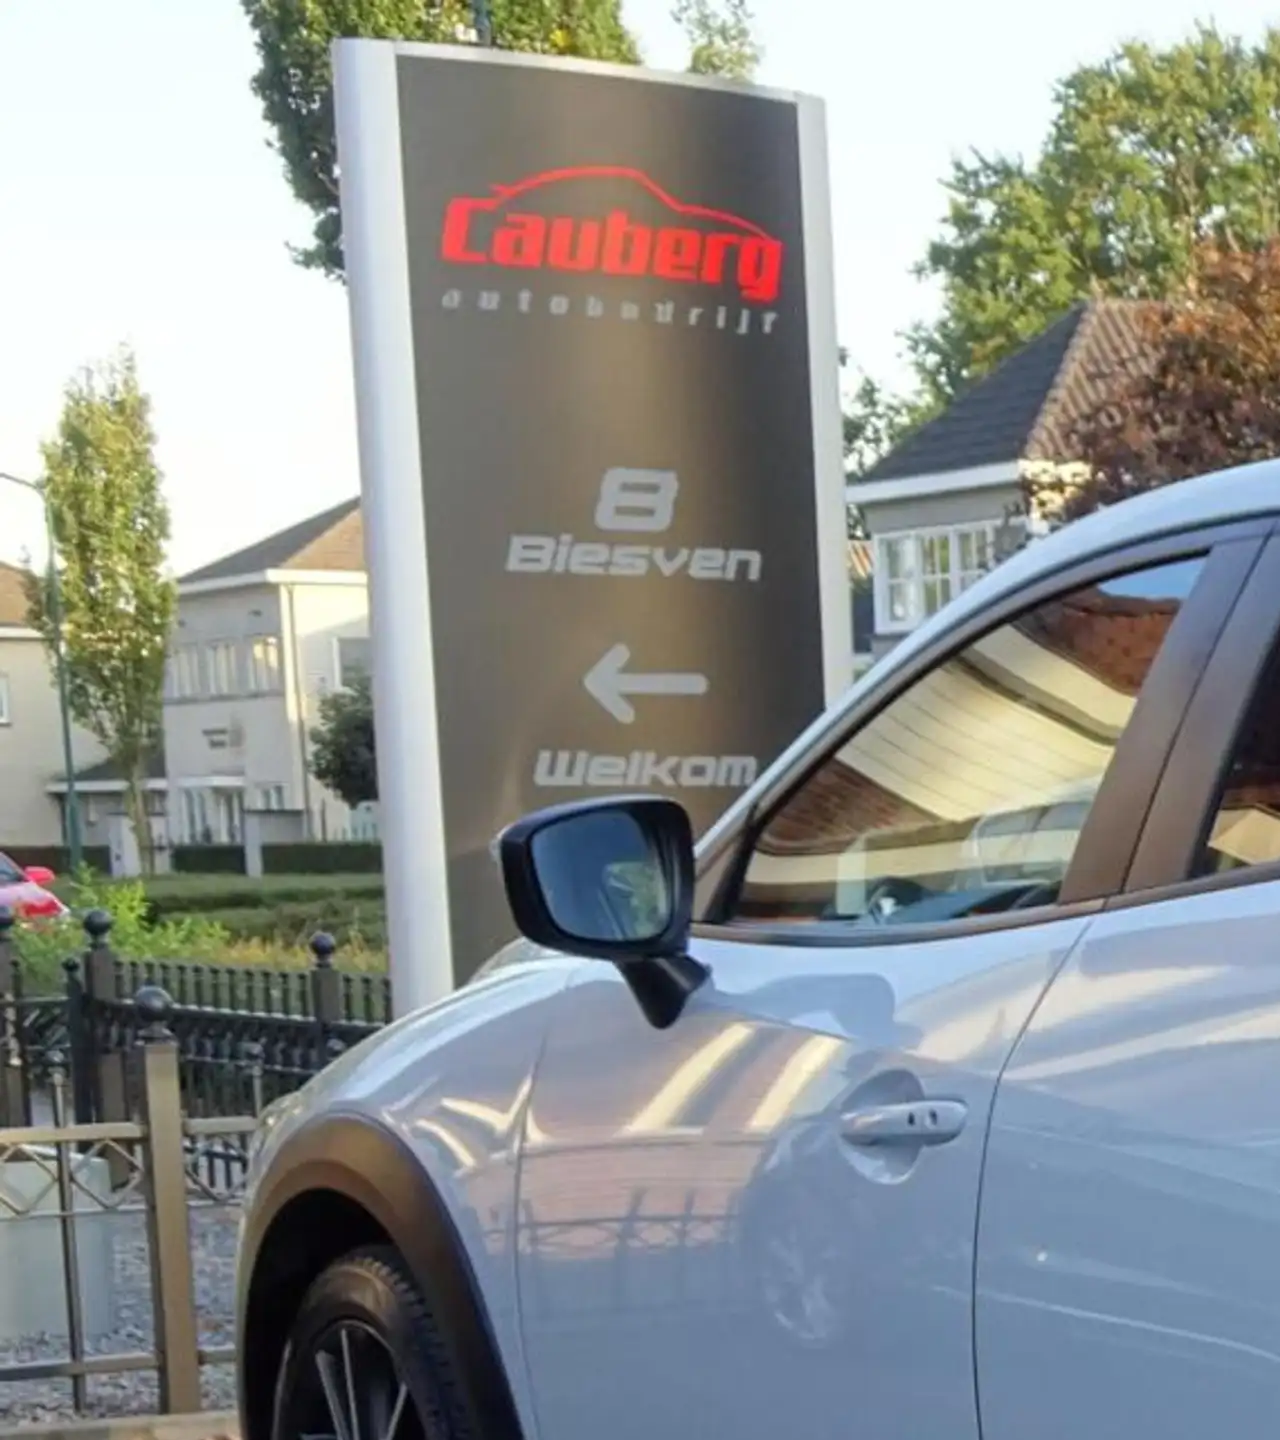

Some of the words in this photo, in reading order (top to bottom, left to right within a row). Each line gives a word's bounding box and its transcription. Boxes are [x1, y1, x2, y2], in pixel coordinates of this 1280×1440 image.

[441, 196, 783, 303] Cauberg
[594, 467, 679, 532] 8
[505, 533, 762, 582] Biesven
[533, 749, 757, 787] Welkom
